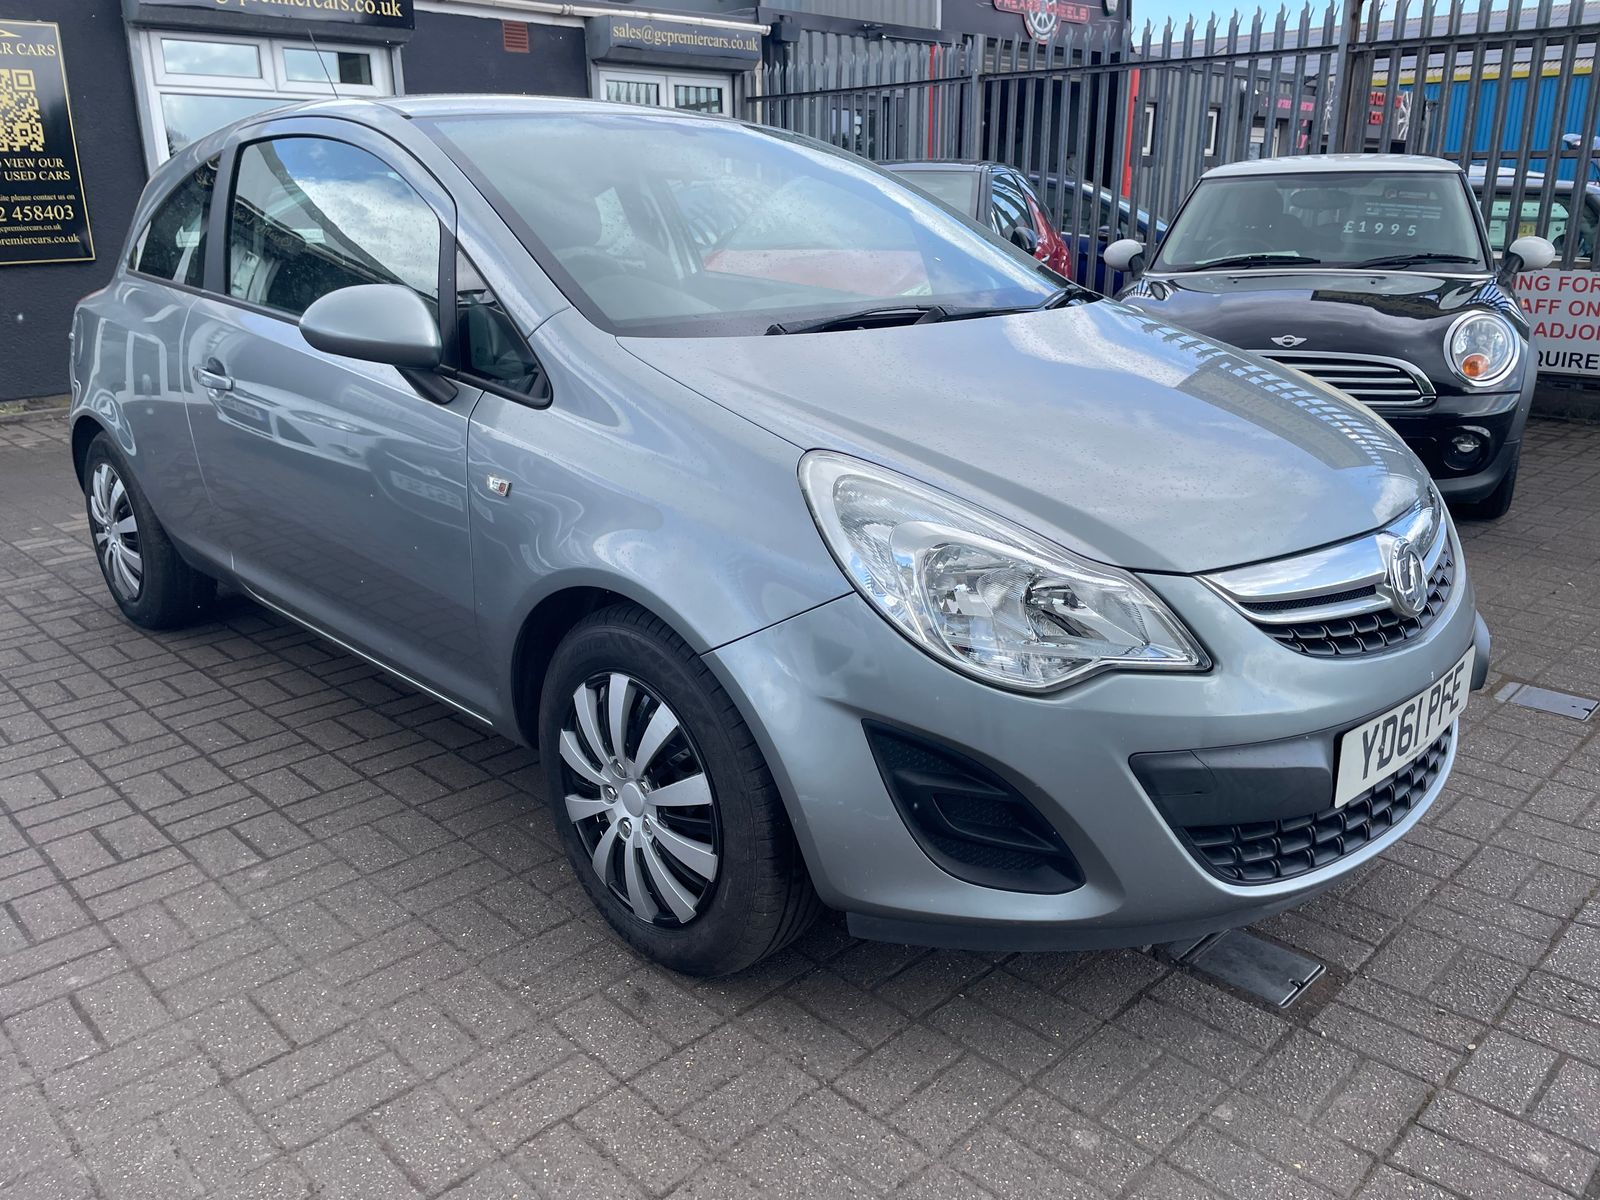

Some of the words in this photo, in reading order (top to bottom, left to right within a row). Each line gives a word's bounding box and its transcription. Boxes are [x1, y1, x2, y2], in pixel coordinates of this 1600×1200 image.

[612, 23, 758, 52] sales@gcpremiercars.co.uk
[16, 43, 56, 56] CARS
[4, 158, 35, 168] VIEW
[38, 158, 64, 168] OUR
[4, 171, 37, 181] USED
[39, 170, 71, 180] CARS
[11, 194, 32, 203] please
[12, 205, 74, 221] 458403
[0, 224, 62, 233] cpremiercars.co.uk
[1362, 697, 1424, 780] YD61
[1425, 661, 1465, 738] PFE
